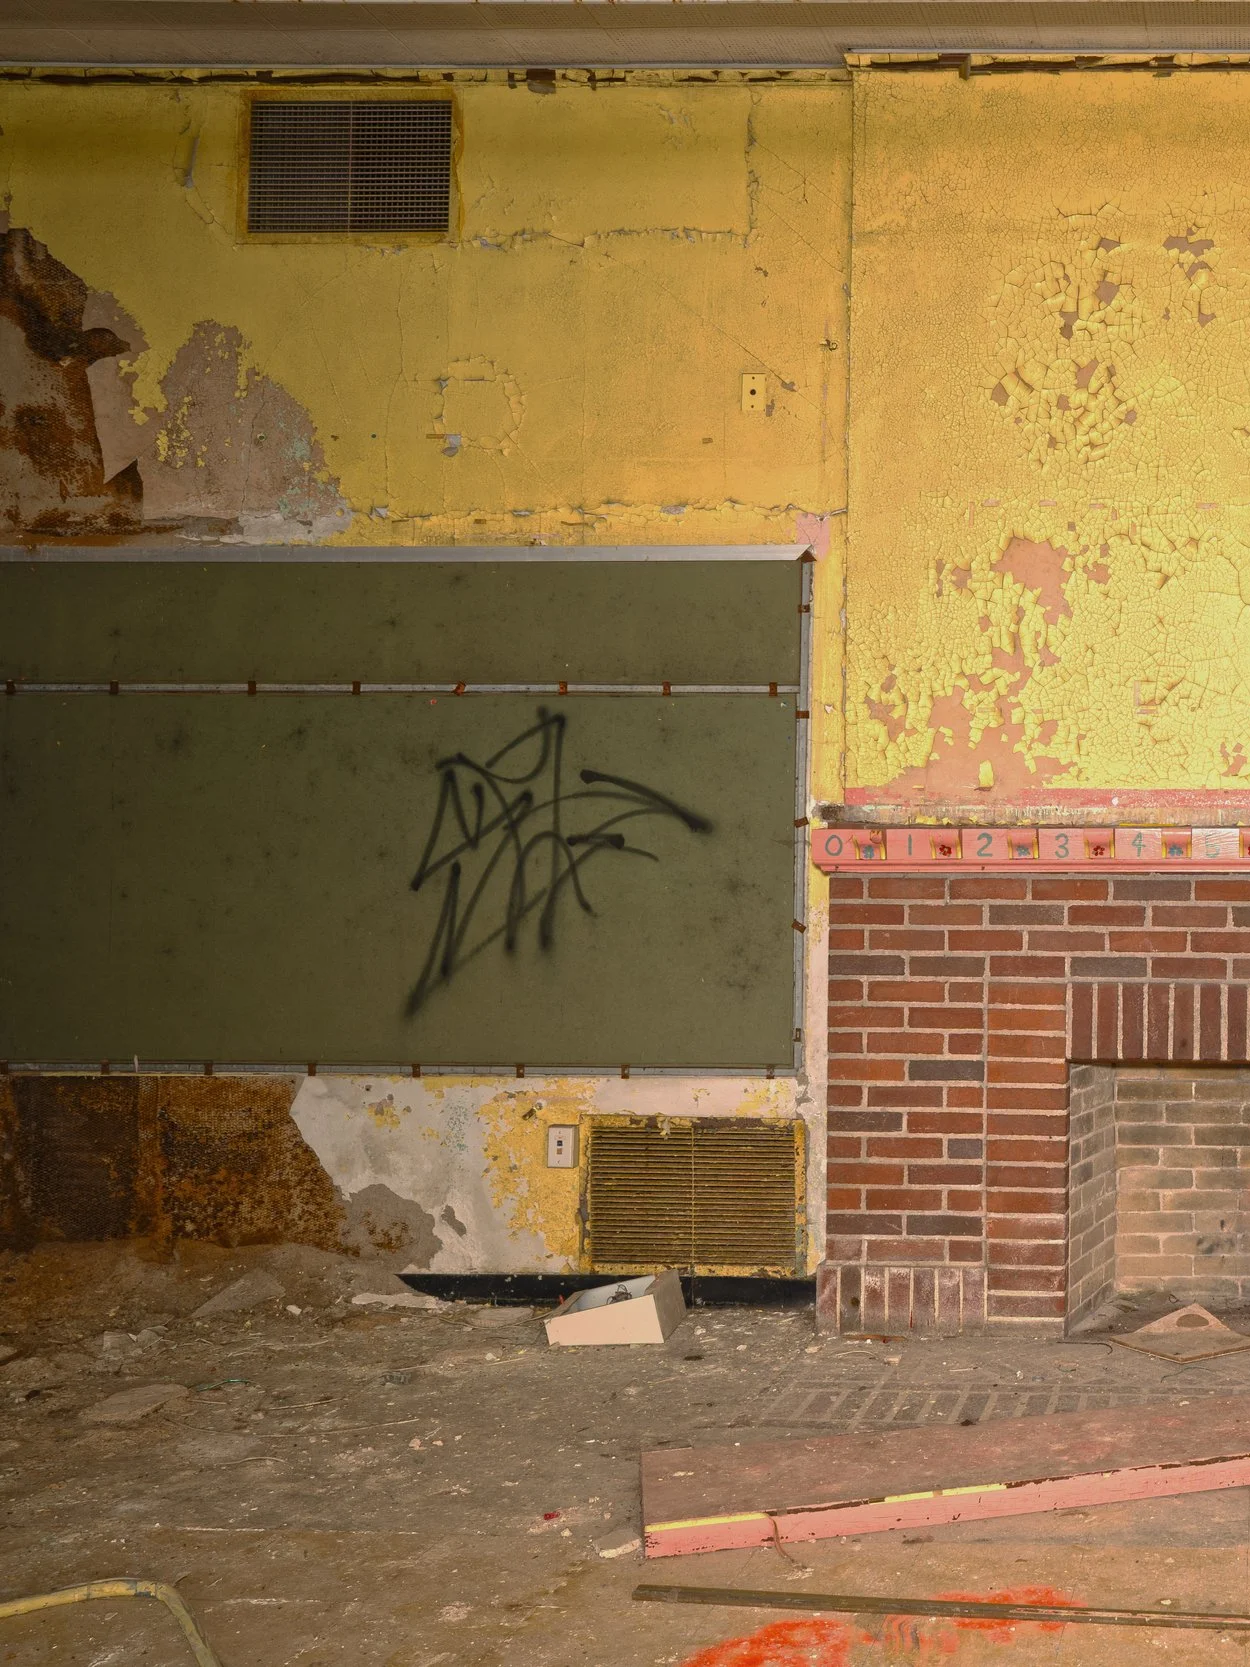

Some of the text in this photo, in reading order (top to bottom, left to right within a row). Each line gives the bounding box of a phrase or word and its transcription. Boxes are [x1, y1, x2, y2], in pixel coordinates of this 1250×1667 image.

[825, 834, 843, 857] 0
[907, 834, 913, 857] 1
[976, 832, 994, 858] 2
[1054, 833, 1070, 859] 3
[1131, 832, 1147, 858] 4
[1205, 831, 1221, 859] 5
